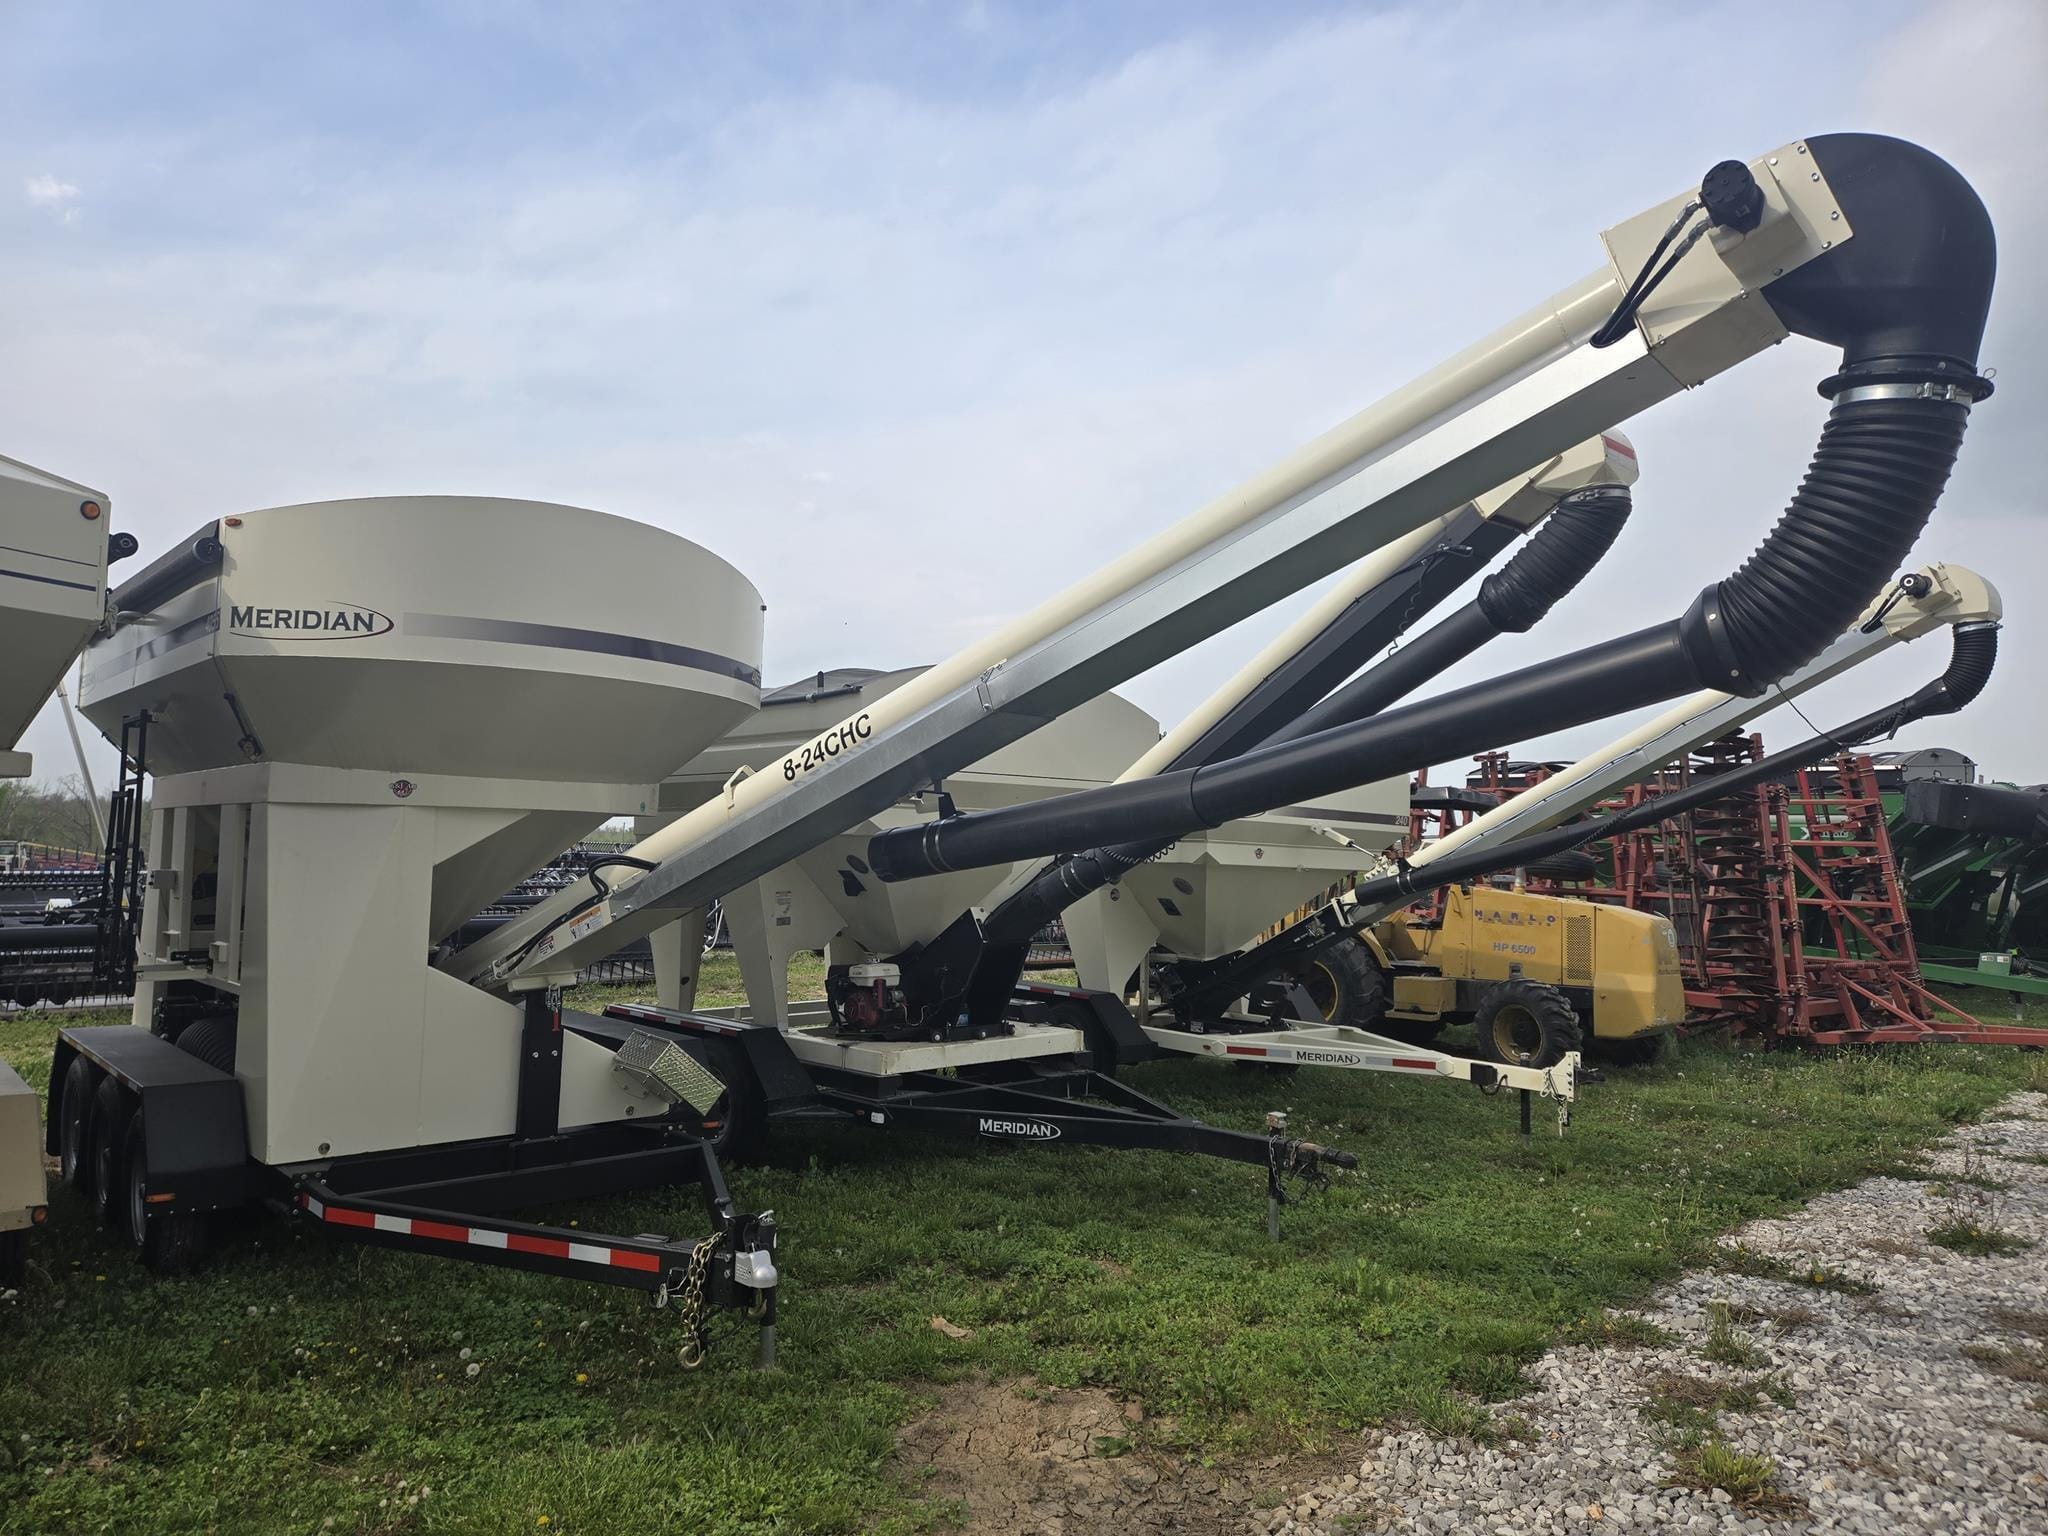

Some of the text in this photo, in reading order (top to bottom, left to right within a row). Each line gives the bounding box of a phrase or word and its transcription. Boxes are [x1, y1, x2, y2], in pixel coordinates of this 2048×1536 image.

[230, 605, 375, 632] MERIDIAN
[783, 713, 872, 781] 8-24CHC
[1493, 942, 1508, 952] HP
[1296, 1050, 1353, 1064] MERIDIAN
[979, 1118, 1051, 1137] MERIDIAN
